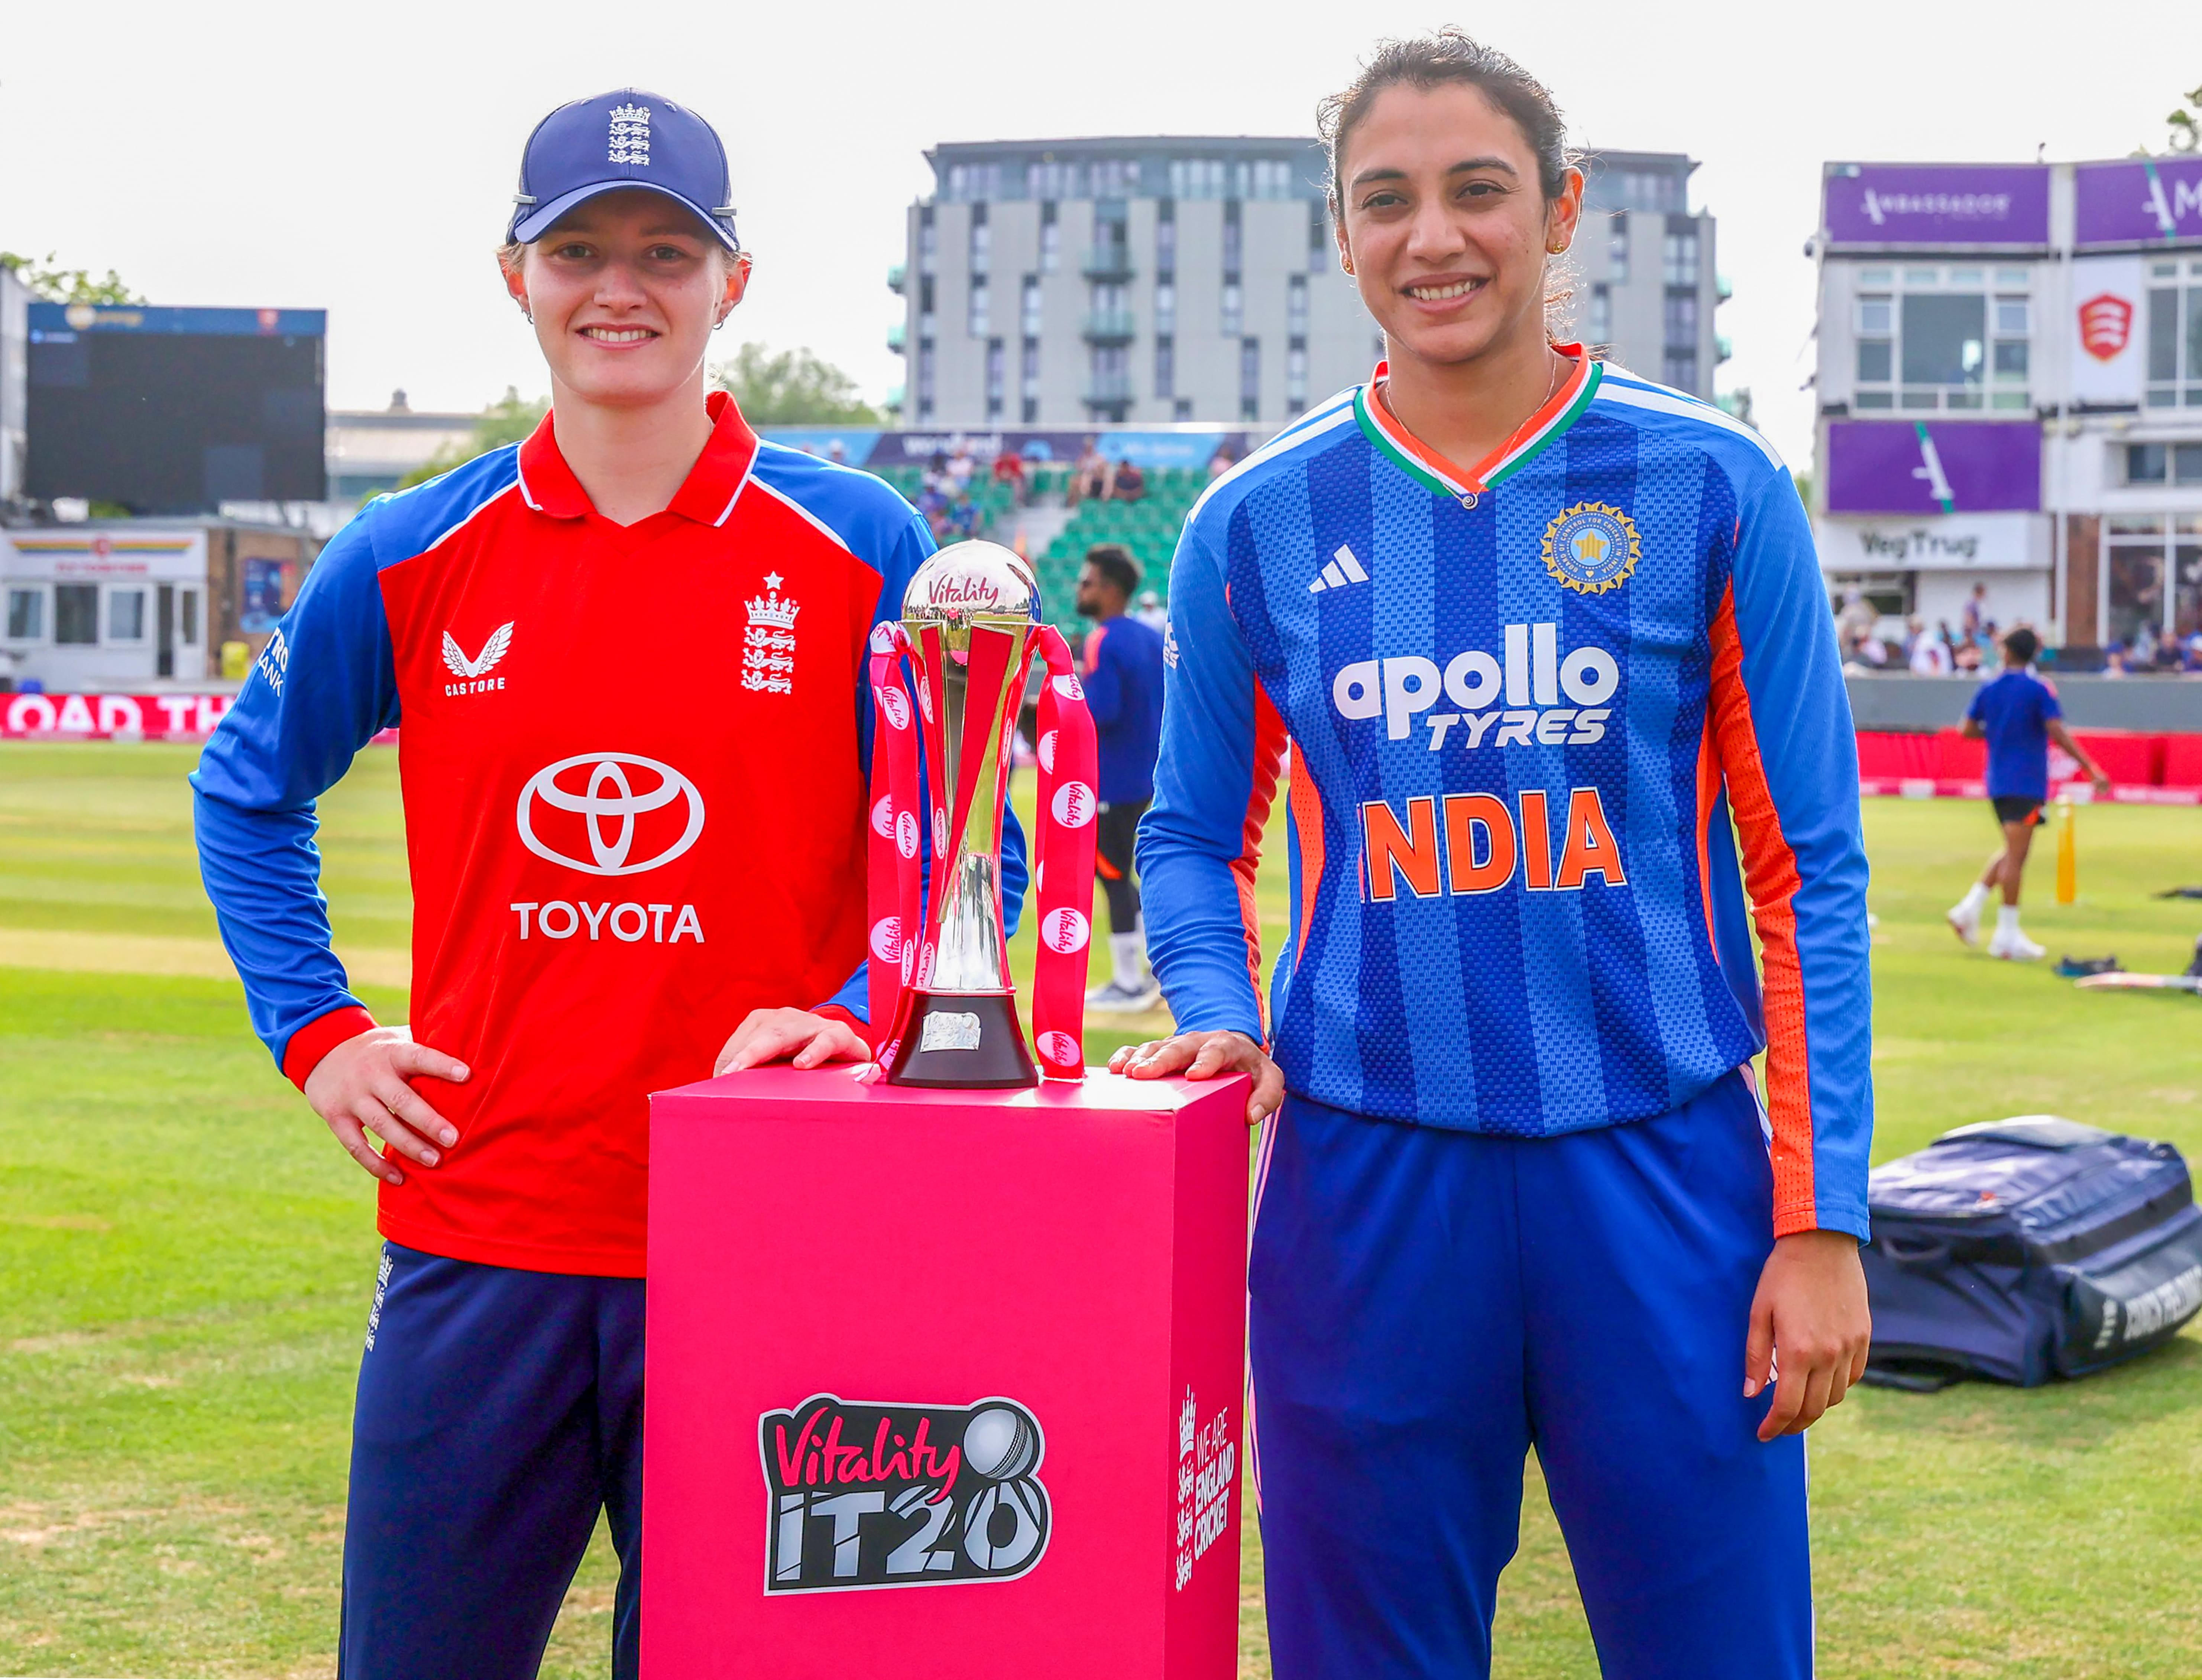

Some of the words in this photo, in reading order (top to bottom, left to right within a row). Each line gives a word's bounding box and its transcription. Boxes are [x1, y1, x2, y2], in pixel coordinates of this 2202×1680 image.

[1561, 519, 1586, 541] CONTROL
[1603, 521, 1622, 546] CRICKET
[1561, 554, 1578, 573] BOARD
[1602, 558, 1619, 573] INDIA
[929, 573, 999, 609] Vitality
[266, 627, 288, 673] TRO
[259, 648, 284, 697] ANK
[445, 677, 505, 697] CASTORE
[1332, 622, 1619, 740] apollo
[7, 693, 143, 732] OAD
[1425, 708, 1612, 751] TYRES
[1061, 784, 1085, 826] Vitality
[902, 813, 912, 856] Vitality
[1357, 786, 1628, 903] NDIA
[510, 900, 705, 943] TOYOTA
[1052, 910, 1078, 951] Vitality
[1050, 1033, 1069, 1064] Vitality
[776, 1407, 961, 1505] Vitality
[1197, 1423, 1211, 1470] WE
[1211, 1407, 1228, 1457] ARE
[1195, 1441, 1234, 1517] ENGLAND
[1195, 1487, 1229, 1560] CRICKET
